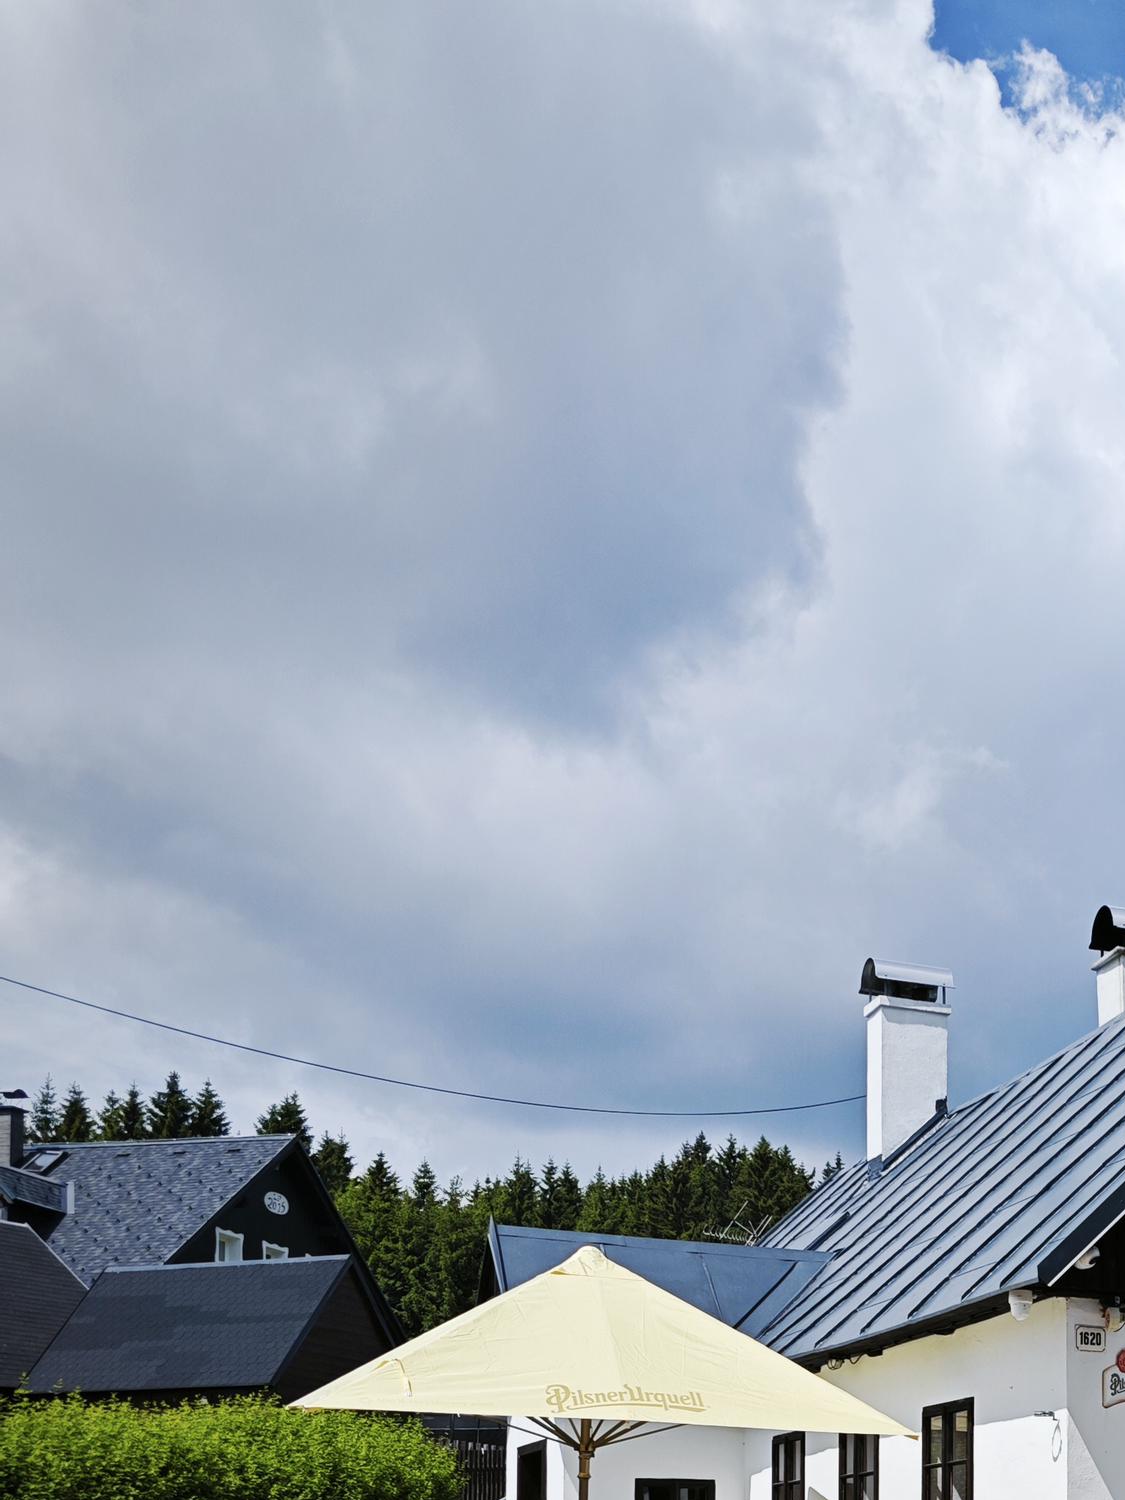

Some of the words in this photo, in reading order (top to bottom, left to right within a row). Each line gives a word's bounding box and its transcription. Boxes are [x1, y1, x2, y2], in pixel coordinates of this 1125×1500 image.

[1079, 1331, 1102, 1346] 1620
[546, 1384, 627, 1413] Pilsner
[624, 1383, 705, 1411] Urquell
